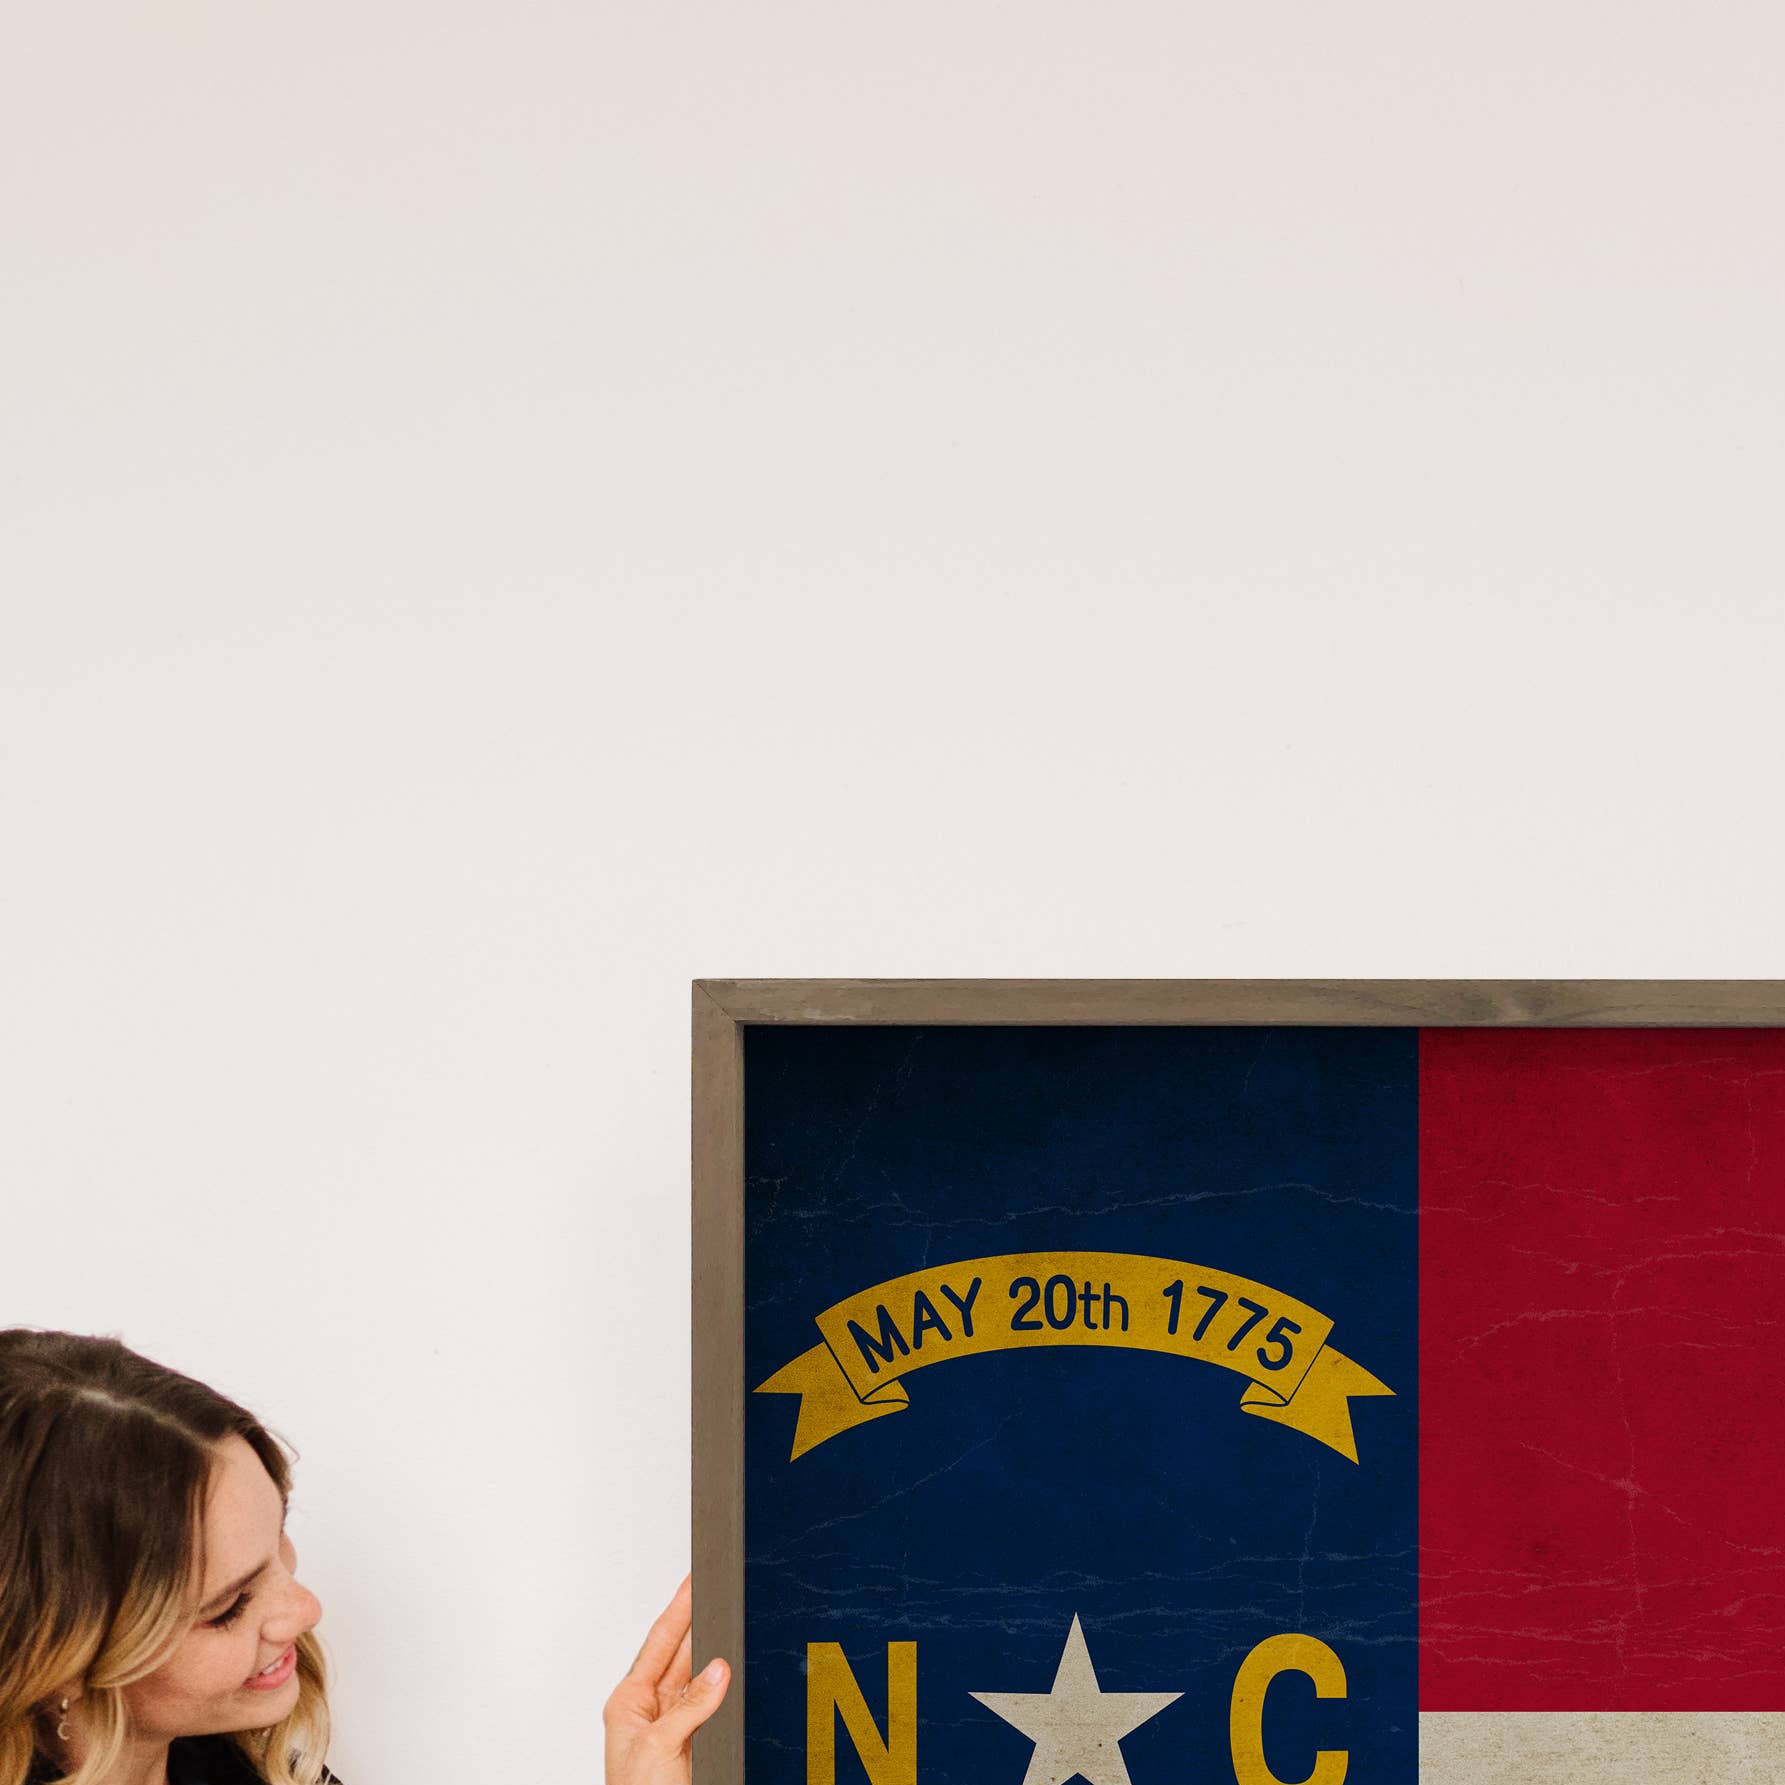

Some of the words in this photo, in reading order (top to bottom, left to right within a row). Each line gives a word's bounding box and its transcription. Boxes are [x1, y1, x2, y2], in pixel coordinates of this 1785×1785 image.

[847, 1277, 982, 1373] MAY
[1009, 1275, 1129, 1331] 20th
[1163, 1279, 1302, 1371] 1775
